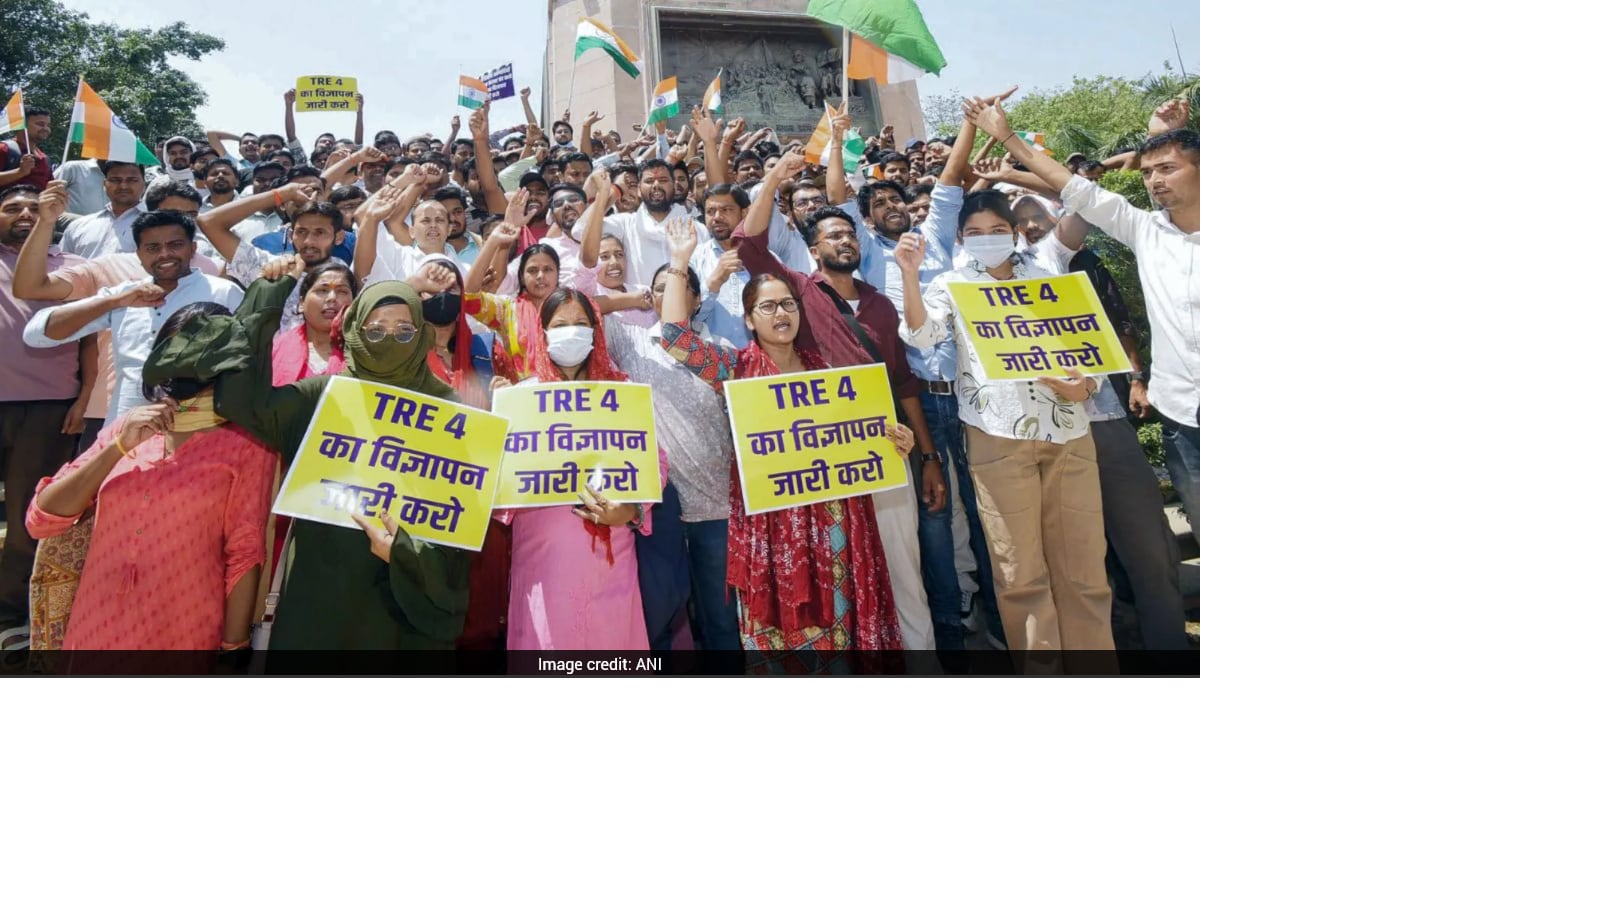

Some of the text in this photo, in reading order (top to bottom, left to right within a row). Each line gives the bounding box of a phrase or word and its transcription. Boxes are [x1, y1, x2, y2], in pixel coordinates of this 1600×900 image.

[979, 283, 1059, 306] TRE 4
[972, 313, 1101, 339] का विज्ञापन
[996, 342, 1104, 372] जारी करो
[534, 388, 620, 413] TRE 4
[768, 375, 857, 410] TRE 4
[373, 391, 468, 440] TRE 4
[504, 423, 648, 453] का विज्ञापन
[746, 415, 887, 456] का विज्ञापन
[319, 431, 489, 490] का विज्ञापन
[768, 450, 885, 496] जारी करो
[514, 461, 580, 495] जारी
[399, 496, 465, 533] करो
